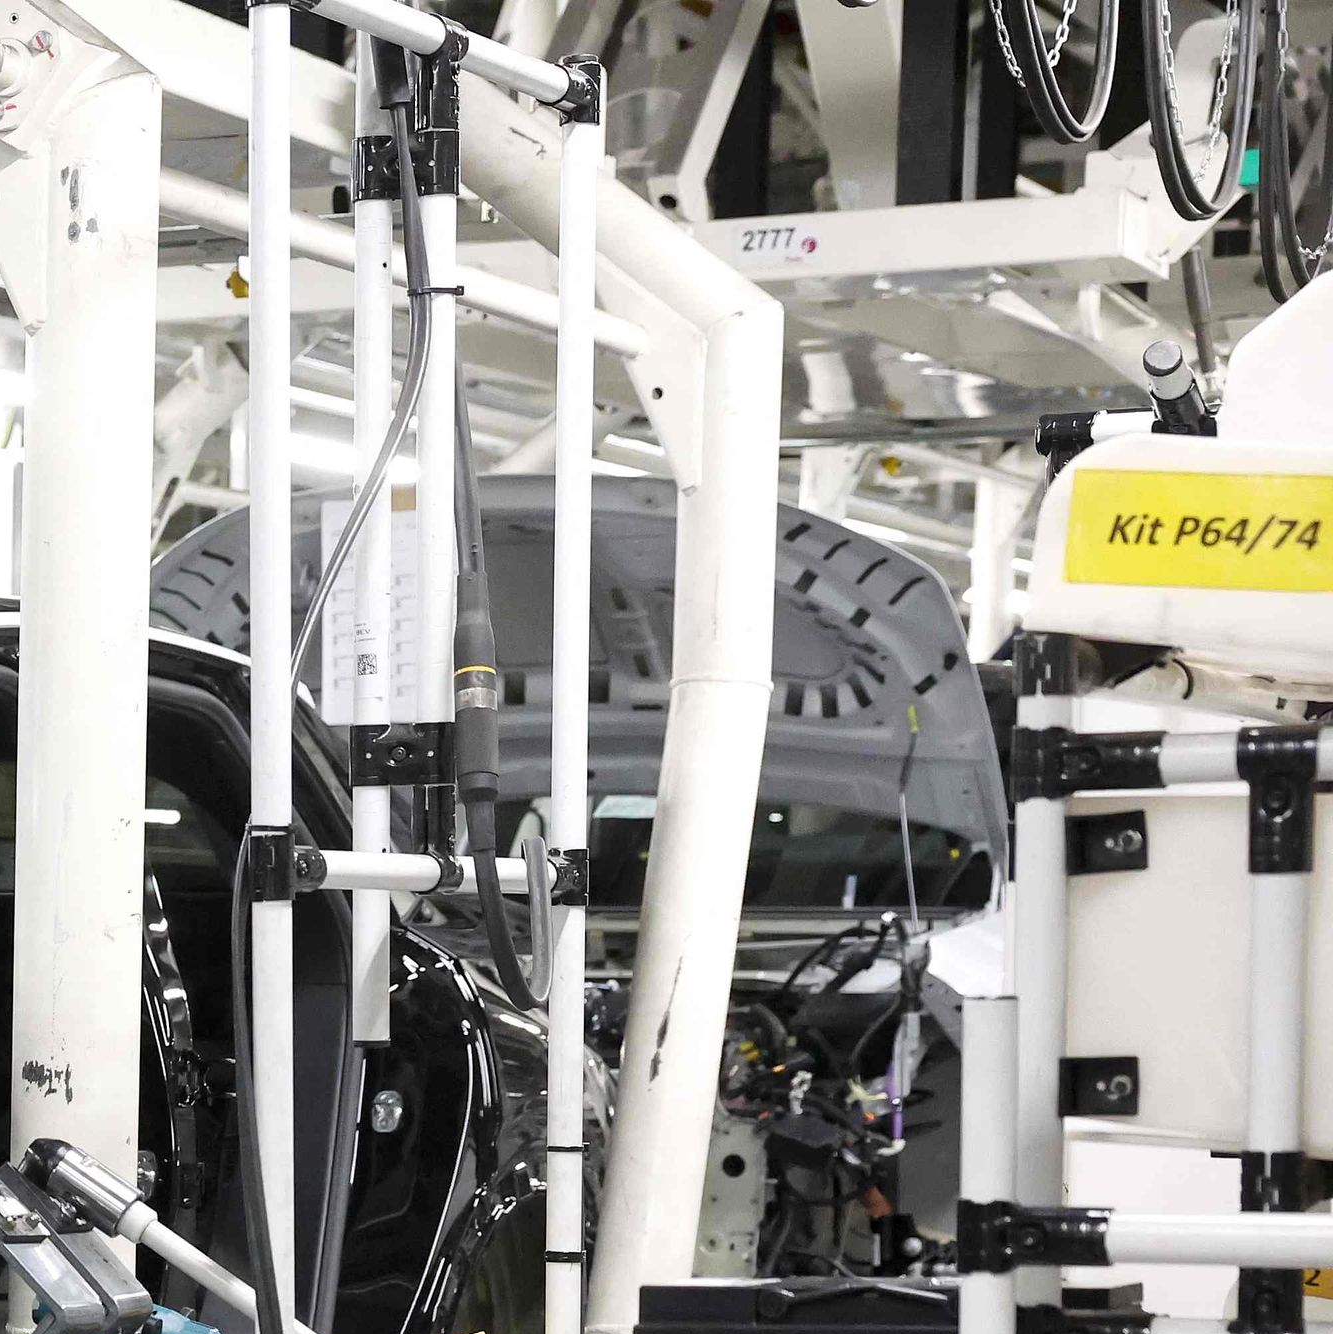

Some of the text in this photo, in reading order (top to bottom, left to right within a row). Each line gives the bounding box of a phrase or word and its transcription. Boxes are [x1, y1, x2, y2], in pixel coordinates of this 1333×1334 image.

[742, 226, 795, 252] 2777
[1108, 513, 1321, 555] Kit P64/74
